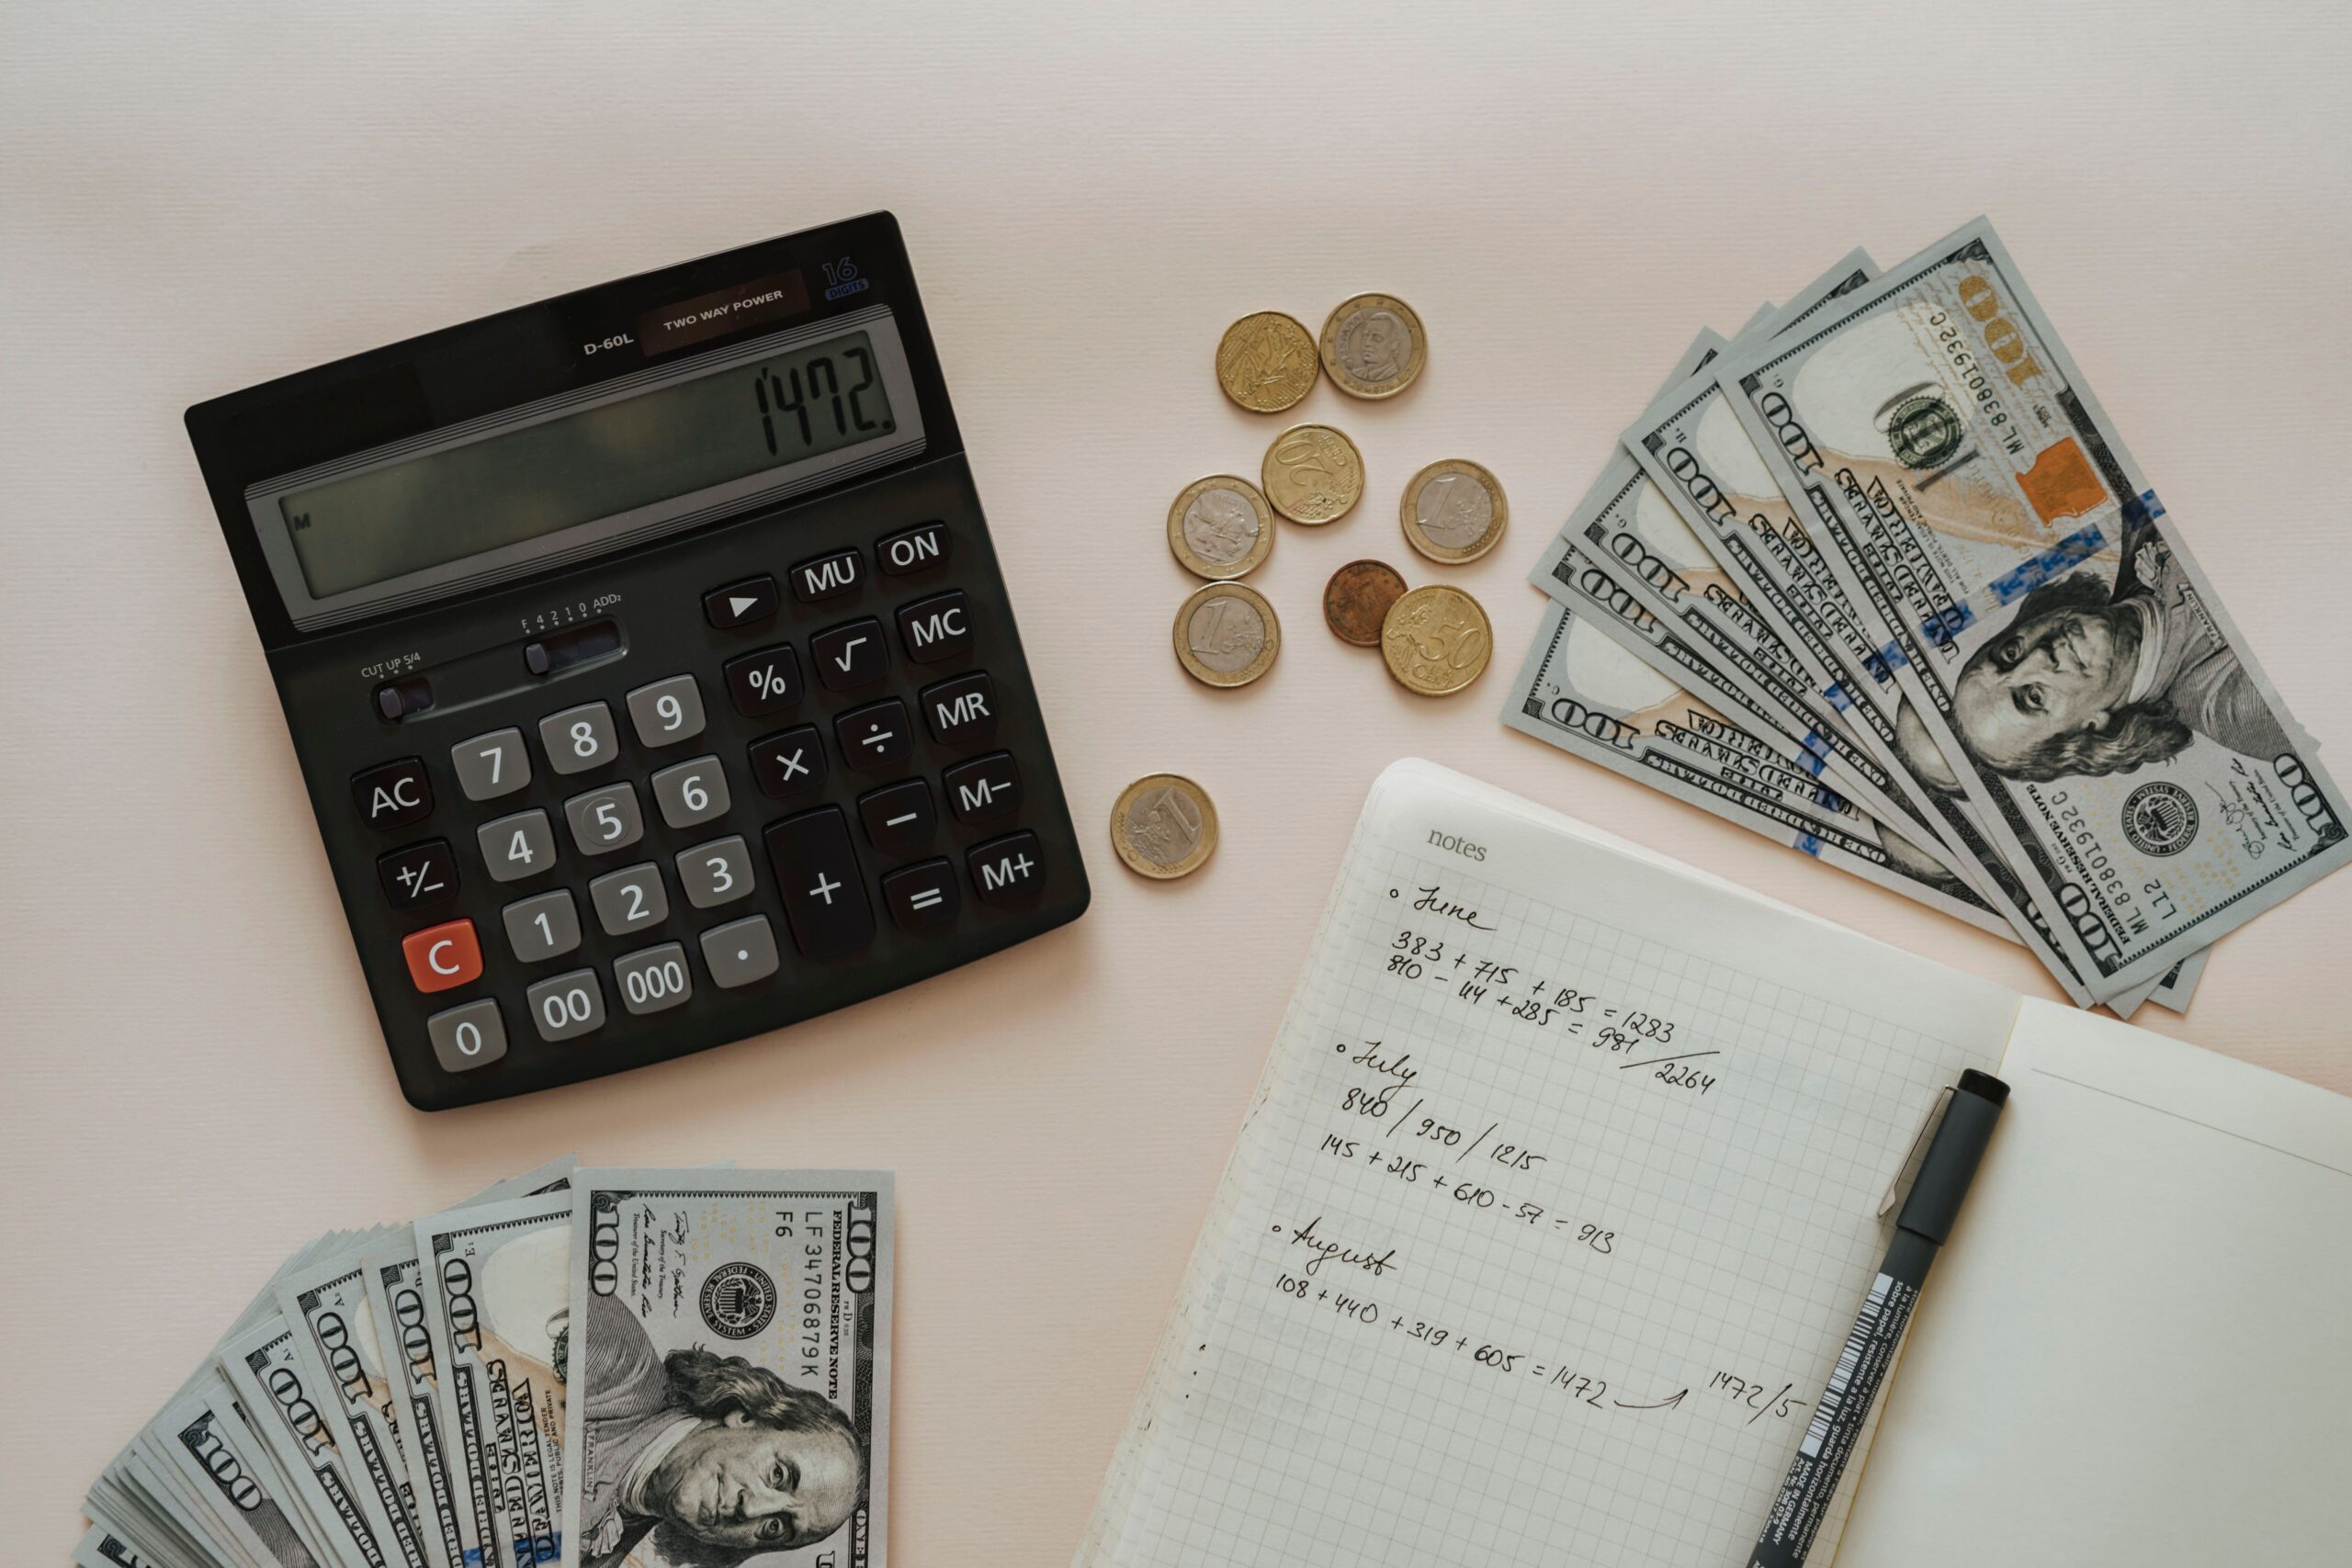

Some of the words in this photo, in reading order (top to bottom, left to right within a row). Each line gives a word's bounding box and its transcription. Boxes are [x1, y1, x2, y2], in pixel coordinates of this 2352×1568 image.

[821, 256, 858, 286] 16
[829, 279, 867, 299] DIGITS
[663, 315, 697, 332] TWO
[699, 305, 729, 321] WAY
[732, 289, 784, 311] POWER
[1928, 310, 1948, 328] C
[583, 333, 635, 355] D-60L
[1958, 275, 2042, 387] 100
[1938, 325, 2009, 427] 83801932
[1756, 387, 1826, 479] 100
[1998, 424, 2027, 456] ML
[1667, 447, 1737, 528] 100
[291, 512, 312, 532] M
[1809, 489, 1869, 577] DOLLARS
[1832, 467, 1904, 568] STATES
[889, 531, 942, 567] ON
[1860, 475, 1947, 600] AMERICA
[803, 556, 857, 594] MU
[1607, 526, 1690, 607] 100
[1860, 542, 1905, 604] THE
[521, 619, 528, 629] F
[536, 615, 544, 625] 4
[550, 611, 559, 621] 2
[565, 606, 571, 616] 1
[579, 603, 587, 613] 0
[911, 607, 967, 648] MC
[1863, 577, 1927, 672] HUNDRED
[1890, 561, 1962, 664] UNITED
[1932, 592, 1966, 632] OF
[2184, 592, 2217, 639] FRANKLIN
[1419, 616, 1481, 670] 50
[361, 663, 384, 678] CUT
[386, 658, 401, 671] UP
[403, 651, 422, 666] 5/4
[1921, 672, 1949, 708] ONE
[657, 694, 684, 731] 9
[937, 693, 989, 730] MR
[1548, 694, 1641, 752] 100
[572, 723, 599, 757] 8
[480, 748, 504, 784] 7
[370, 776, 422, 818] AC
[683, 776, 709, 812] 6
[2025, 782, 2054, 822] NOTE
[2050, 789, 2069, 807] C
[2268, 748, 2337, 838] 100
[596, 804, 623, 840] 5
[506, 829, 534, 865] 4
[1427, 828, 1488, 863] notes
[2047, 818, 2092, 884] RESERVE
[2059, 804, 2132, 908] 83801932
[707, 858, 733, 893] 3
[982, 854, 1035, 892] M+
[620, 886, 649, 921] 2
[1413, 886, 1498, 931] June
[2086, 882, 2131, 945] FEDERAL
[2142, 877, 2177, 920] L12
[533, 912, 556, 946] 1
[2054, 877, 2124, 969] 100
[2121, 906, 2149, 935] ML
[428, 940, 458, 976] C
[627, 961, 684, 1003] 000
[1393, 931, 1443, 961] 383
[1475, 960, 1519, 984] 715
[1554, 987, 1596, 1014] 185
[1622, 1010, 1674, 1043] 1283
[542, 988, 592, 1028] 00
[1387, 955, 1422, 979] 810
[1512, 1000, 1560, 1026] 285
[1593, 1026, 1640, 1055] 981
[457, 1021, 481, 1056] 0
[1352, 1041, 1419, 1103] July
[1655, 1062, 1716, 1094] 2264
[1341, 1088, 1388, 1118] 840
[1417, 1119, 1462, 1146] 950
[1490, 1143, 1547, 1171] 1215
[1321, 1134, 1360, 1159] 145
[1386, 1156, 1428, 1183] 215
[1453, 1182, 1495, 1209] 610
[1514, 1202, 1544, 1225] 57
[1577, 1224, 1615, 1255] 913
[658, 1229, 666, 1254] Secretary
[775, 1211, 793, 1238] F6
[805, 1211, 822, 1237] LF
[592, 1205, 619, 1297] 100
[831, 1209, 842, 1280] FEDERAL
[845, 1201, 873, 1293] 100
[1291, 1217, 1397, 1276] August
[713, 1266, 747, 1282] FEDERAL
[753, 1272, 773, 1301] UNITED
[443, 1258, 482, 1354] 100
[702, 1283, 714, 1318] RESERVE
[802, 1244, 821, 1358] 34706879
[1886, 1280, 1905, 1308] sobre
[1900, 1292, 1910, 1303] la
[712, 1320, 745, 1336] SYSTEM
[752, 1303, 771, 1329] STATES
[829, 1282, 840, 1354] RESERVE
[1872, 1307, 1892, 1338] papel,
[394, 1289, 437, 1384] 100
[1275, 1273, 1309, 1299] 108
[1334, 1293, 1379, 1324] 440
[1408, 1321, 1449, 1347] 319
[1474, 1344, 1524, 1373] 605
[1550, 1365, 1610, 1410] 1472
[317, 1312, 373, 1404] 100
[801, 1365, 819, 1376] K
[1853, 1338, 1880, 1386] resistente
[1864, 1341, 1889, 1385] conserver
[828, 1358, 838, 1399] NOTE
[1849, 1385, 1858, 1393] a
[268, 1368, 336, 1457] 100
[455, 1370, 480, 1466] DOLLARS
[484, 1358, 521, 1475] STATES
[544, 1389, 554, 1419] PRIVATE
[1836, 1404, 1851, 1424] luz,
[1845, 1394, 1856, 1405] la
[1850, 1393, 1867, 1415] plat
[540, 1406, 550, 1437] TENDER
[549, 1420, 558, 1436] AND
[1839, 1422, 1855, 1445] tinta
[509, 1377, 549, 1520] AMERICA
[544, 1438, 554, 1461] LEGAL
[552, 1438, 562, 1466] PUBLIC
[586, 1434, 594, 1489] FRANKLIN
[1819, 1424, 1843, 1461] guarda
[204, 1430, 264, 1512] 100
[484, 1442, 506, 1512] THE
[548, 1462, 556, 1471] IS
[549, 1472, 560, 1493] NOTE
[1795, 1461, 1814, 1488] MADE
[1815, 1445, 1846, 1501] documento,
[553, 1495, 562, 1513] THIS
[1781, 1489, 1792, 1505] 308
[1785, 1460, 1828, 1541] horizontalmente
[1791, 1488, 1801, 1499] IN
[1770, 1499, 1796, 1545] GERMANY
[1789, 1500, 1822, 1559] permanente
